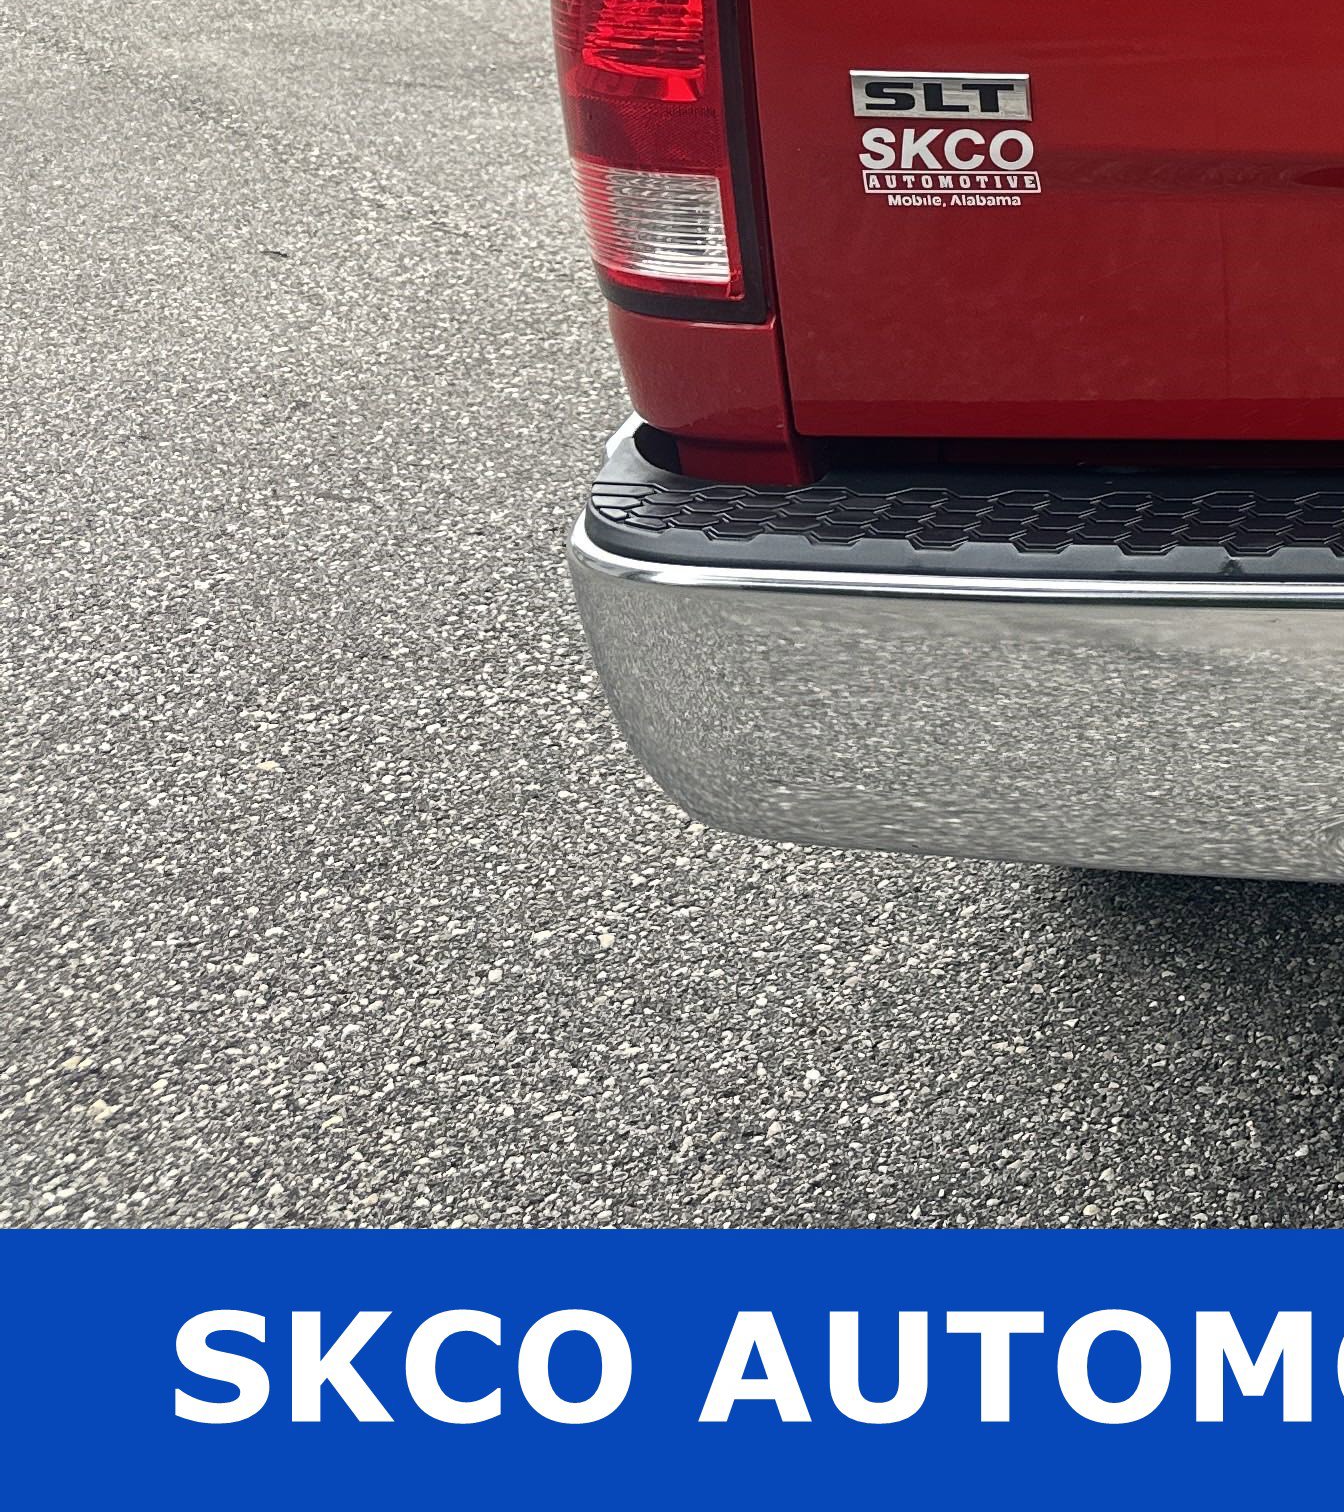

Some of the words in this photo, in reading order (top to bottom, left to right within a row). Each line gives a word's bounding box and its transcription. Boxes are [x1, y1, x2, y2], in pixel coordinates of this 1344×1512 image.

[864, 81, 1015, 113] SLT
[859, 127, 1034, 171] SKCO
[868, 174, 1037, 189] AUTOMOTIVE
[888, 194, 946, 208] Mobile,
[950, 194, 1022, 207] Alabama
